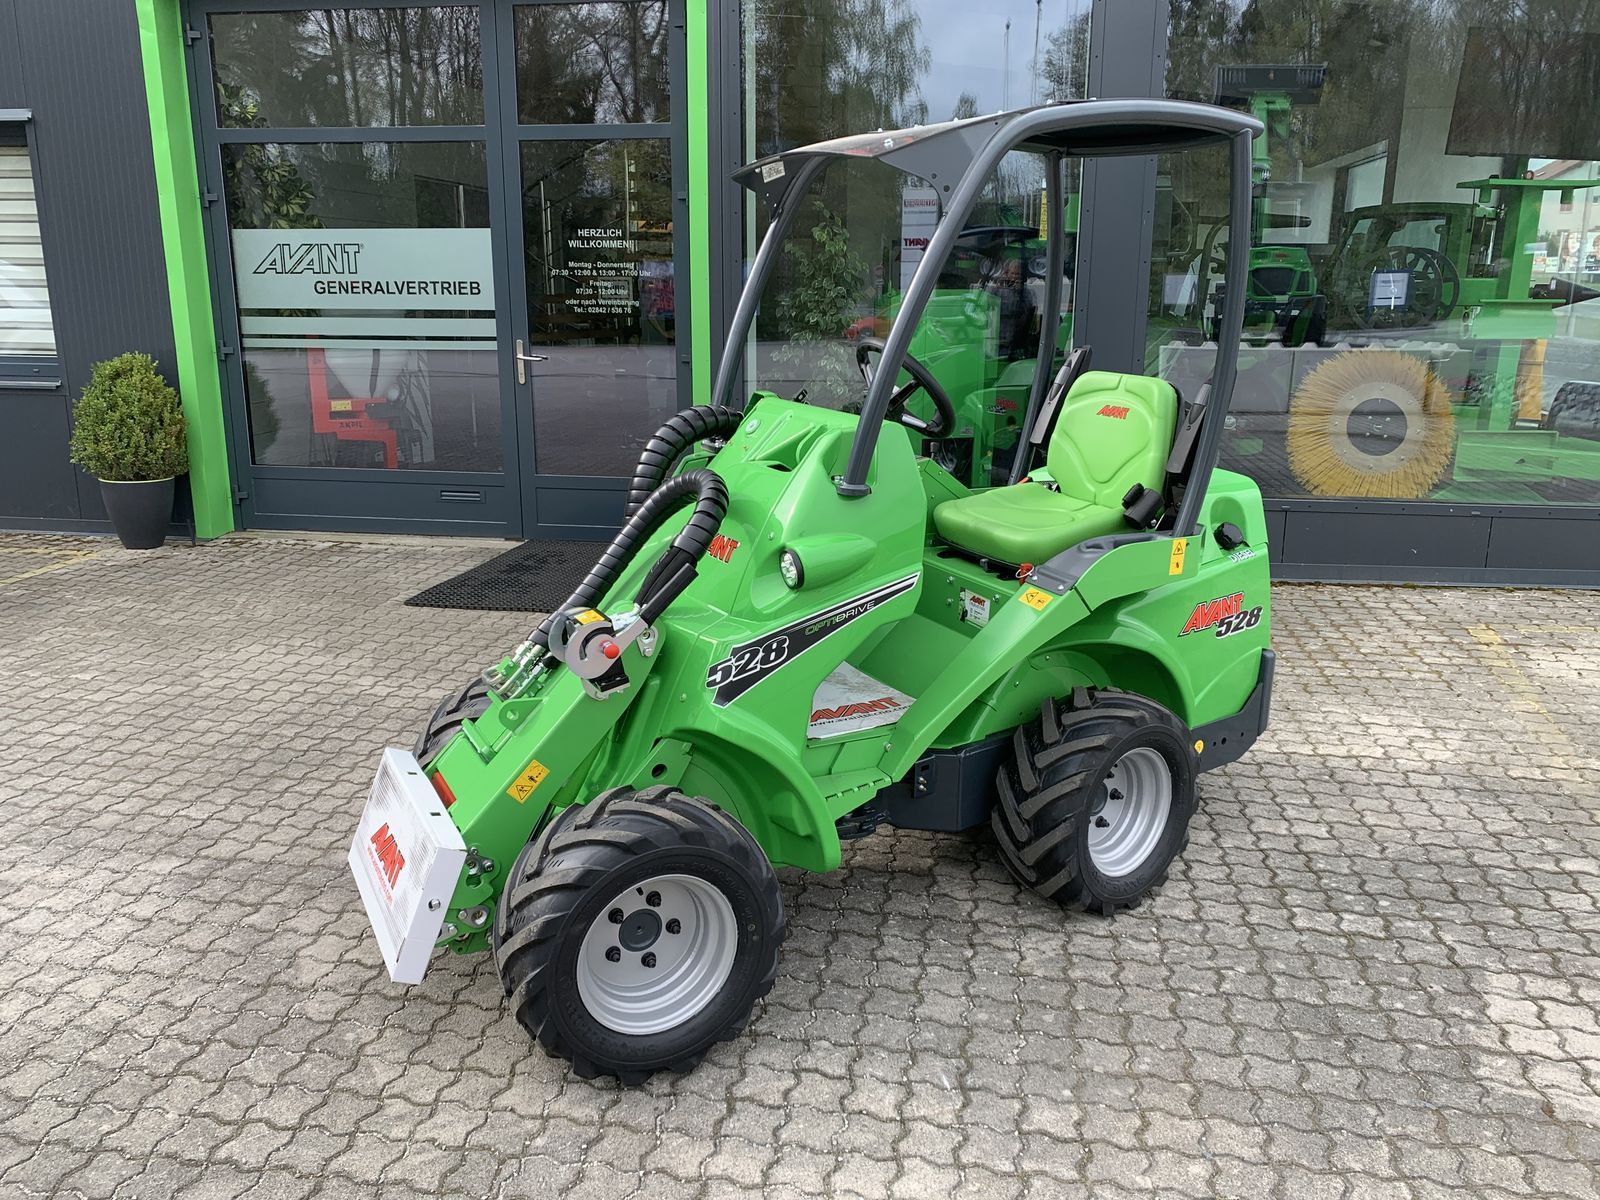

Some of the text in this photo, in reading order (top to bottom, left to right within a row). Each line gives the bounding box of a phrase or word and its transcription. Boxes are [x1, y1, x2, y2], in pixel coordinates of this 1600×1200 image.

[577, 228, 622, 237] HERZLICH
[252, 243, 361, 275] AVANT
[568, 261, 592, 269] Montag
[597, 261, 635, 270] Donnerstag
[640, 269, 652, 277] Uhr
[314, 280, 481, 296] GENERALVERTRIEB
[589, 280, 614, 288] Freitag:
[588, 306, 607, 314] 02842
[597, 299, 640, 307] Vereinbarung
[1096, 404, 1130, 420] AVANT
[804, 600, 876, 636] OPTIDRIVE
[1178, 591, 1244, 637] AVANT
[1215, 605, 1263, 640] 528
[705, 635, 790, 690] 528
[809, 696, 901, 723] AVANT
[370, 822, 406, 891] AVANT
